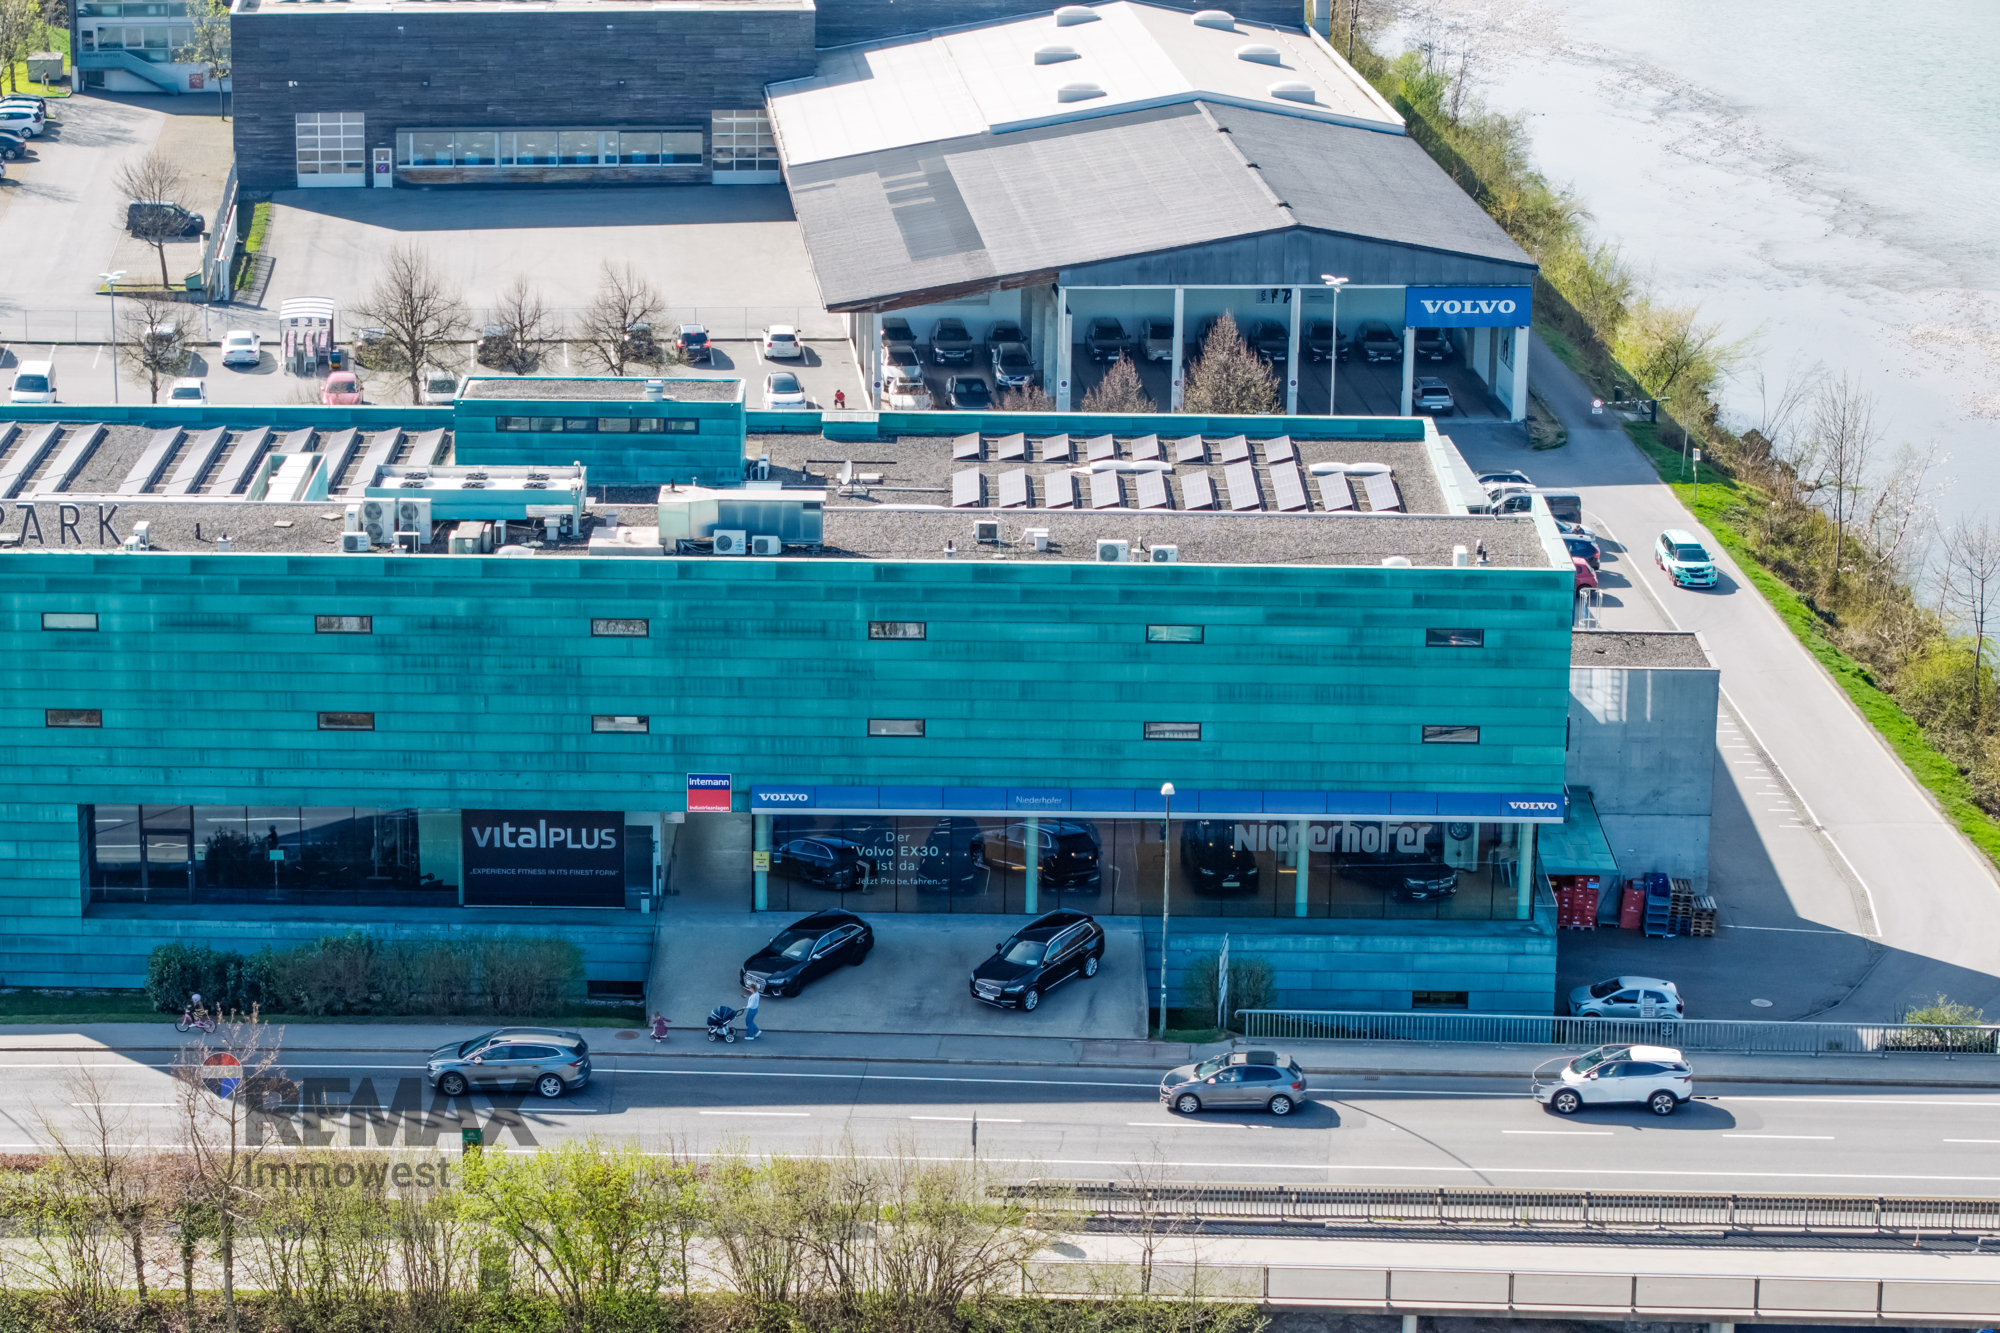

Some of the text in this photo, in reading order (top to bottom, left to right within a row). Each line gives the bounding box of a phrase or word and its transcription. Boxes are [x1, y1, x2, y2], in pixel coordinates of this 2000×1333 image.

[1421, 300, 1516, 314] VOLVO
[0, 502, 121, 545] ARK
[689, 777, 729, 786] intemann
[759, 793, 808, 801] VOLVO
[1015, 796, 1062, 804] Niederhofer
[1508, 801, 1557, 810] VOLVO
[885, 832, 910, 842] Der
[856, 846, 939, 857] Volvo EX30
[877, 860, 919, 870] ist da.
[517, 868, 547, 876] FITNESS
[855, 877, 878, 885] Jetzt
